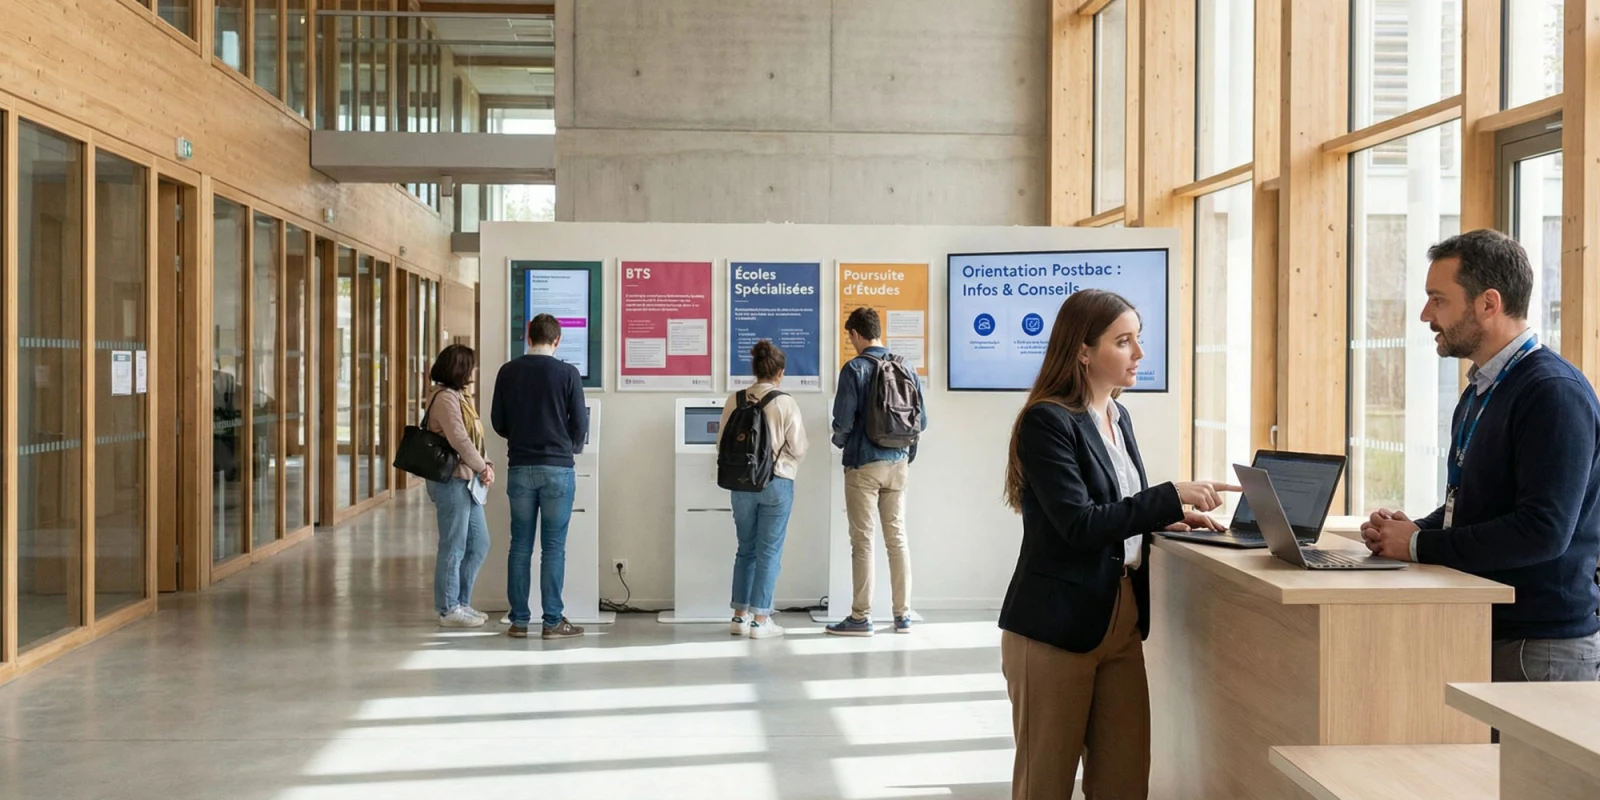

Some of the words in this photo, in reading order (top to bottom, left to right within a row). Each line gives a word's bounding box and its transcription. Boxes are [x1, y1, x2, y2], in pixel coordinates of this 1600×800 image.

[626, 268, 651, 279] BTS
[735, 266, 776, 280] Écoles
[844, 269, 905, 281] Poursuite
[962, 264, 1047, 278] Orientation
[1052, 262, 1112, 277] Postbac
[1117, 264, 1121, 275] :
[735, 283, 814, 297] Spécialisées
[844, 282, 900, 295] d'Études
[963, 283, 998, 296] Infos
[1003, 283, 1013, 296] &
[1018, 281, 1080, 296] Conseils
